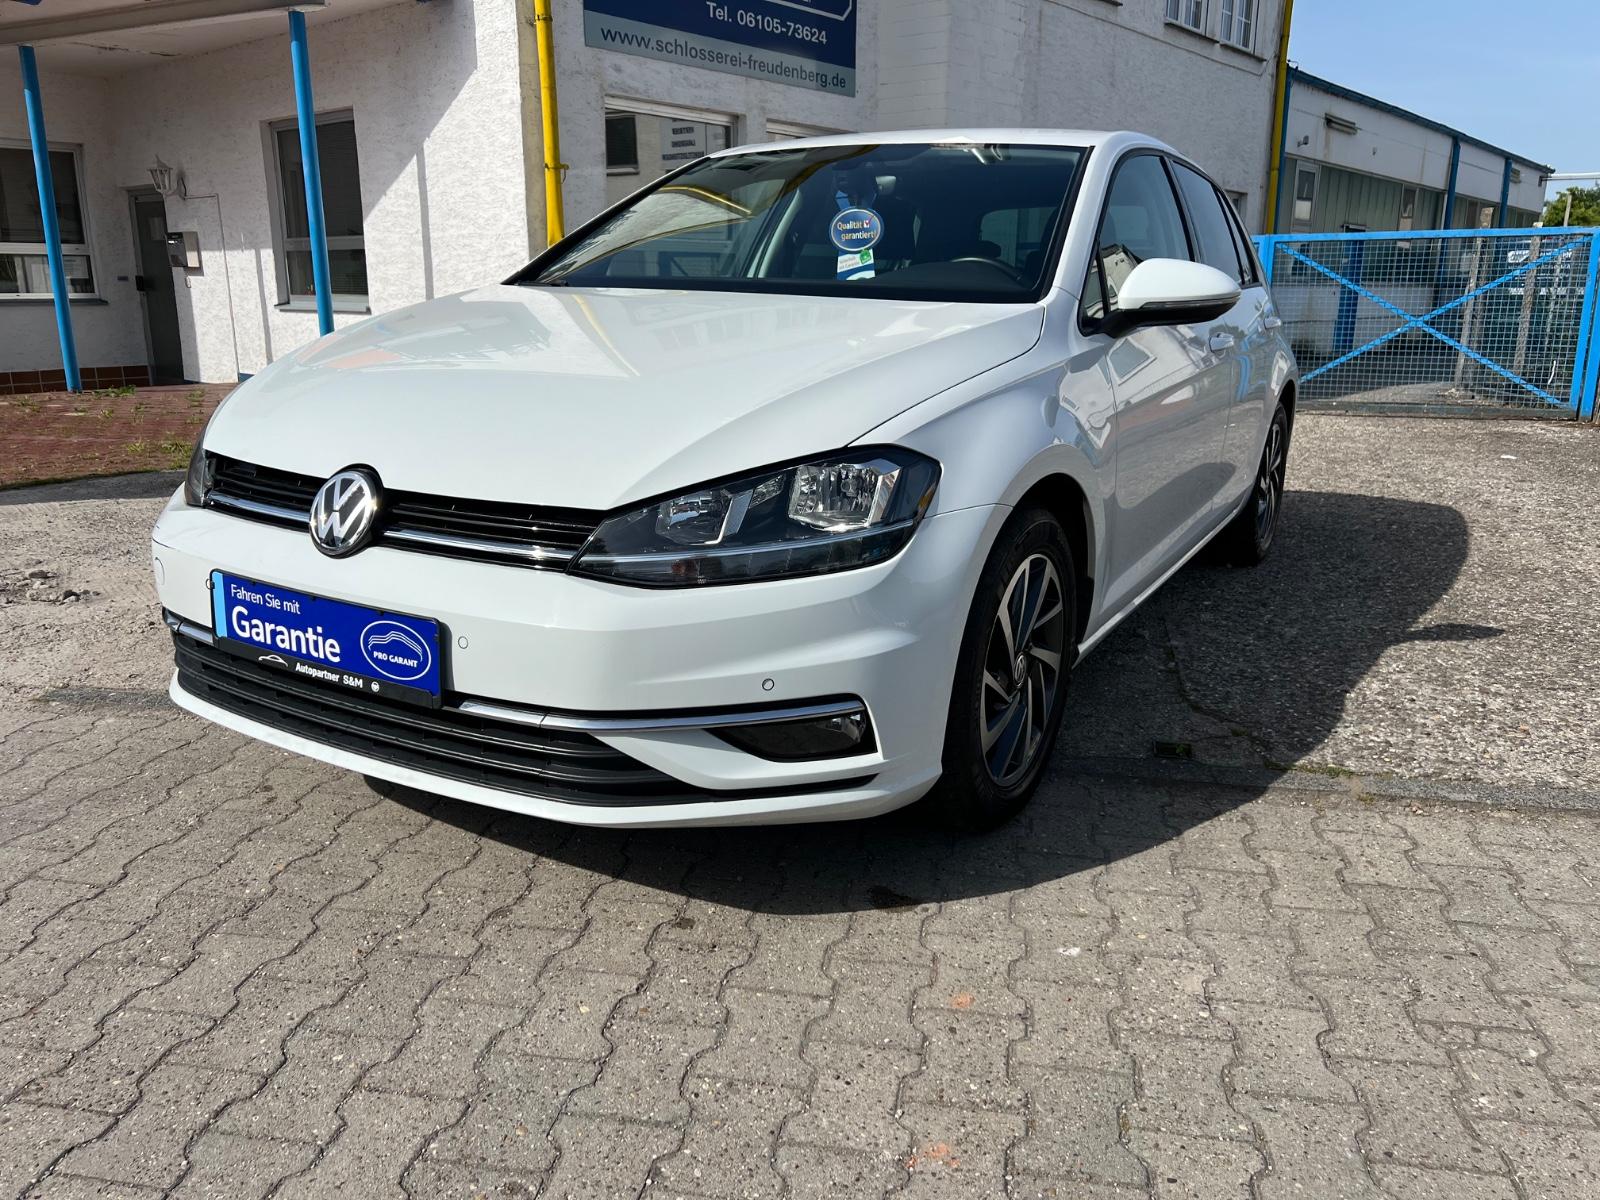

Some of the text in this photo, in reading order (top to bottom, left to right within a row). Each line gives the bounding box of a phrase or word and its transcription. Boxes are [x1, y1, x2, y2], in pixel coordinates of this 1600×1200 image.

[706, 1, 828, 45] Tel. 06105-73624
[601, 27, 847, 89] www.schlosserei-freudenberg.de
[837, 220, 862, 231] Qualität
[230, 583, 301, 615] Fahren Sie mit
[231, 605, 341, 663] Garantie
[295, 662, 364, 688] Autopartner S&M
[373, 651, 419, 668] PRO GARANT
